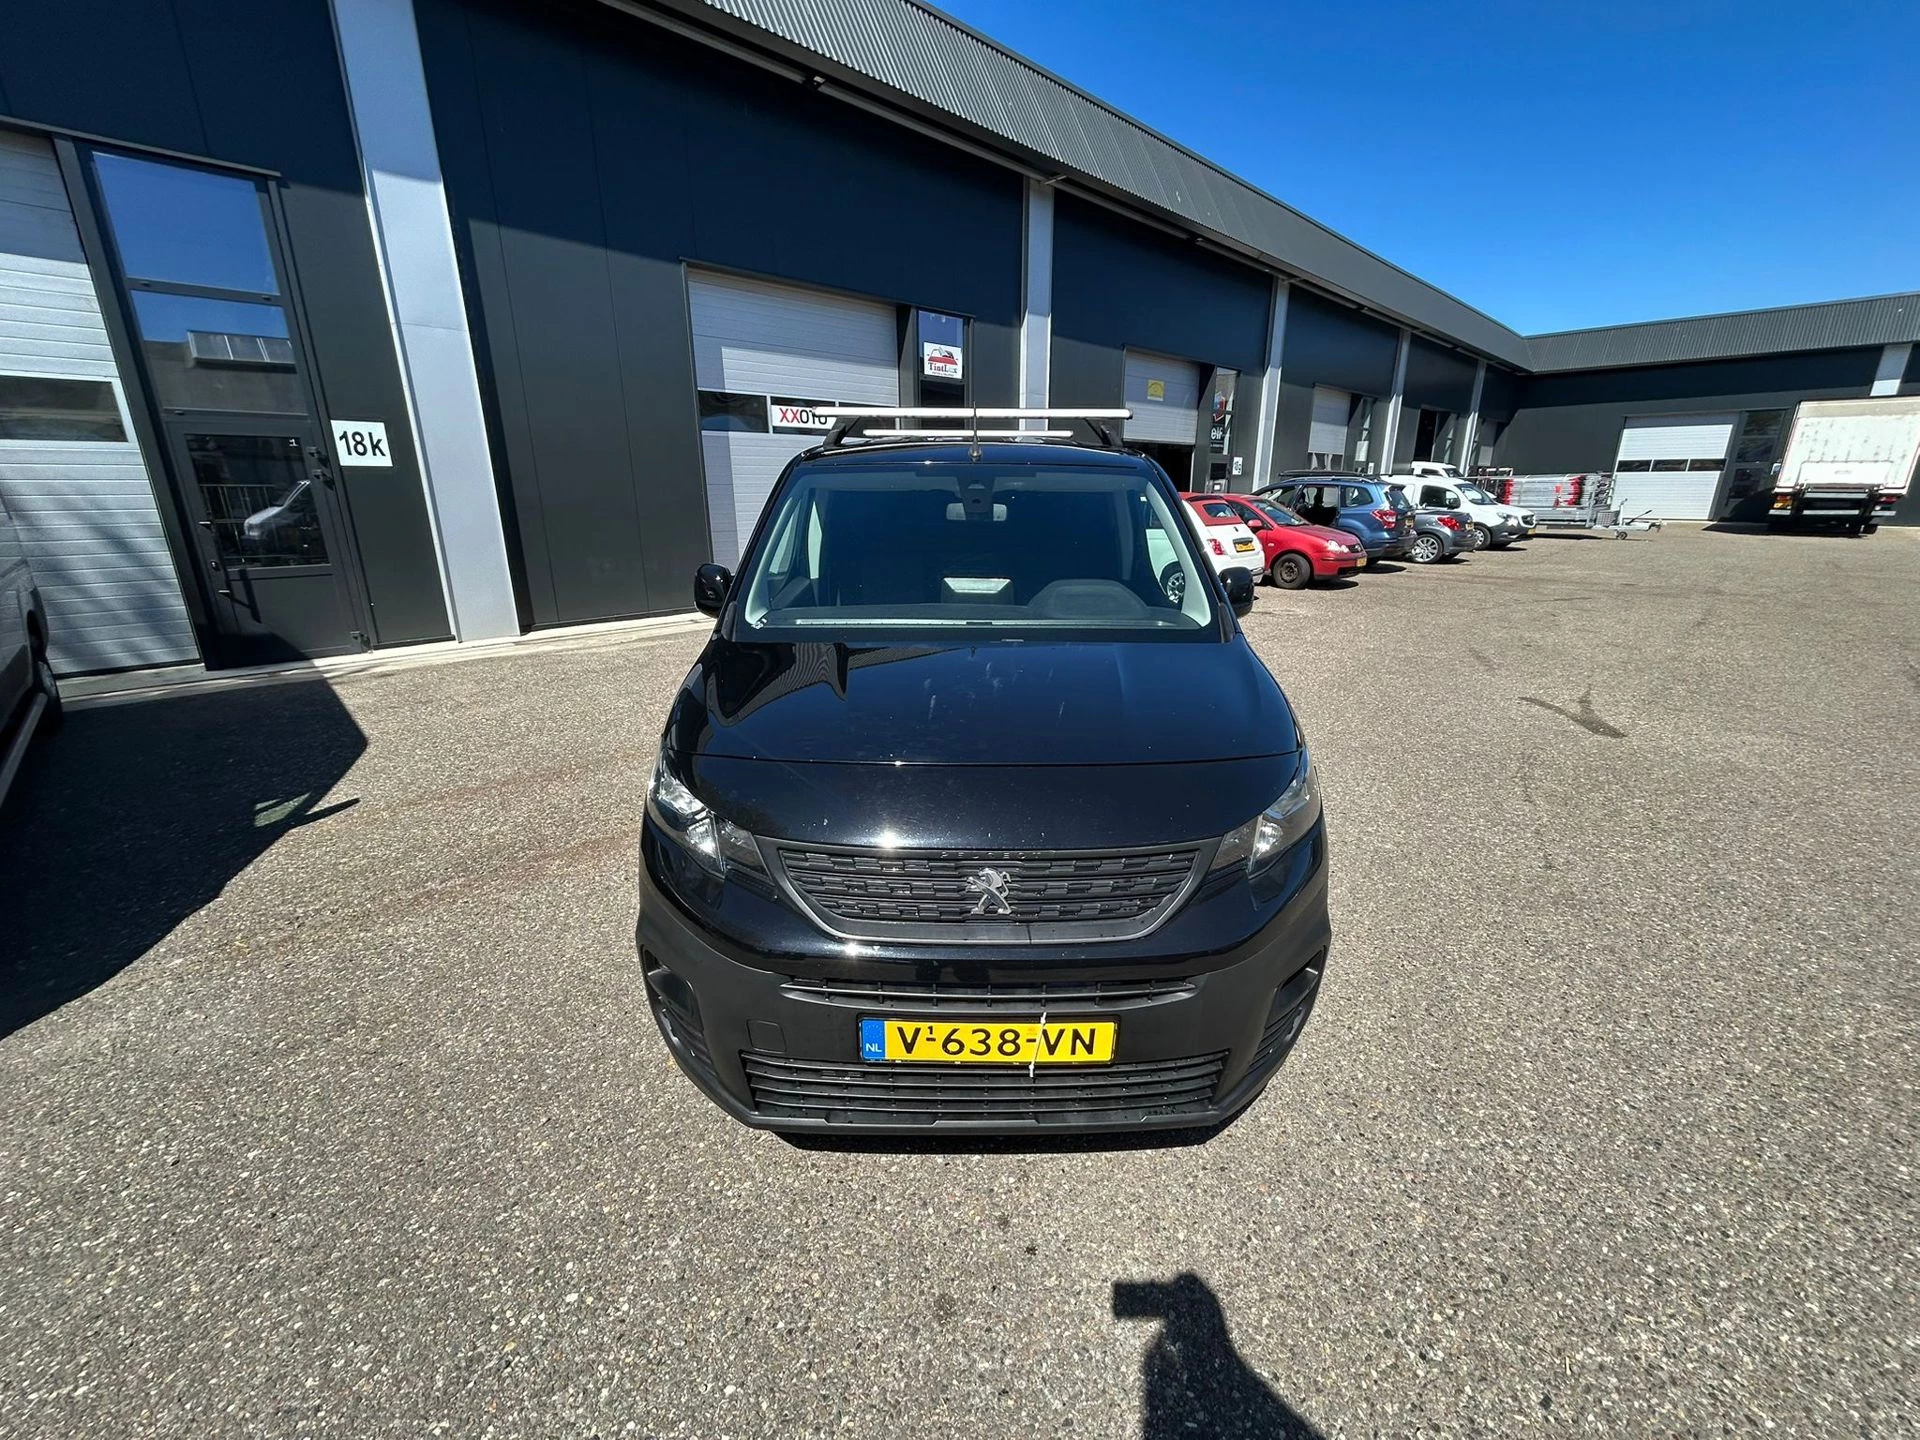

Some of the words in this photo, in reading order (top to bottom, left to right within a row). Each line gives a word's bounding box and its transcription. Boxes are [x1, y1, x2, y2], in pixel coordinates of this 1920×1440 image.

[1210, 426, 1224, 440] elf
[940, 850, 1042, 860] PEUGEOT
[865, 1043, 883, 1053] NL
